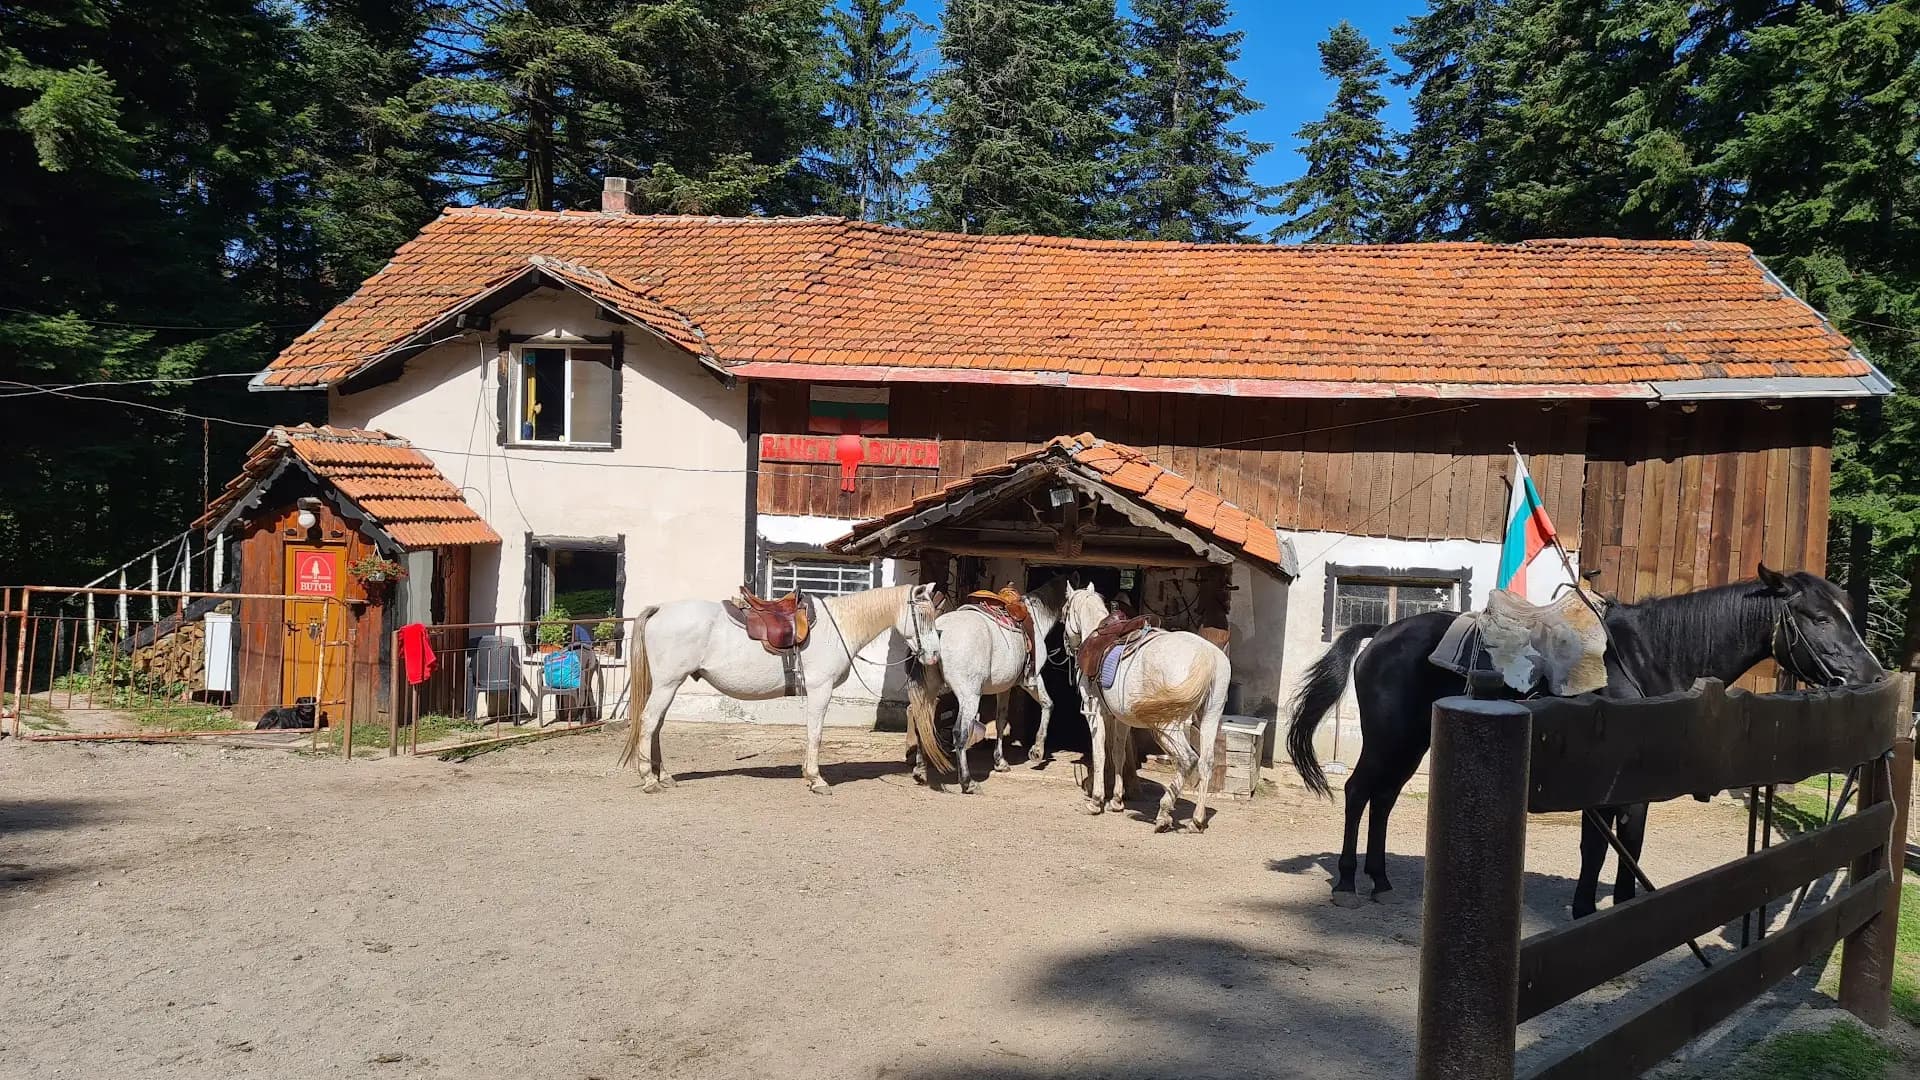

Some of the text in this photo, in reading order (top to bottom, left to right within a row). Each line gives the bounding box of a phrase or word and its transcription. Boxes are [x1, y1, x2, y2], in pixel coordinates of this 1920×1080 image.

[762, 436, 939, 466] RANCH BUTCH
[301, 582, 331, 591] BUTCH
